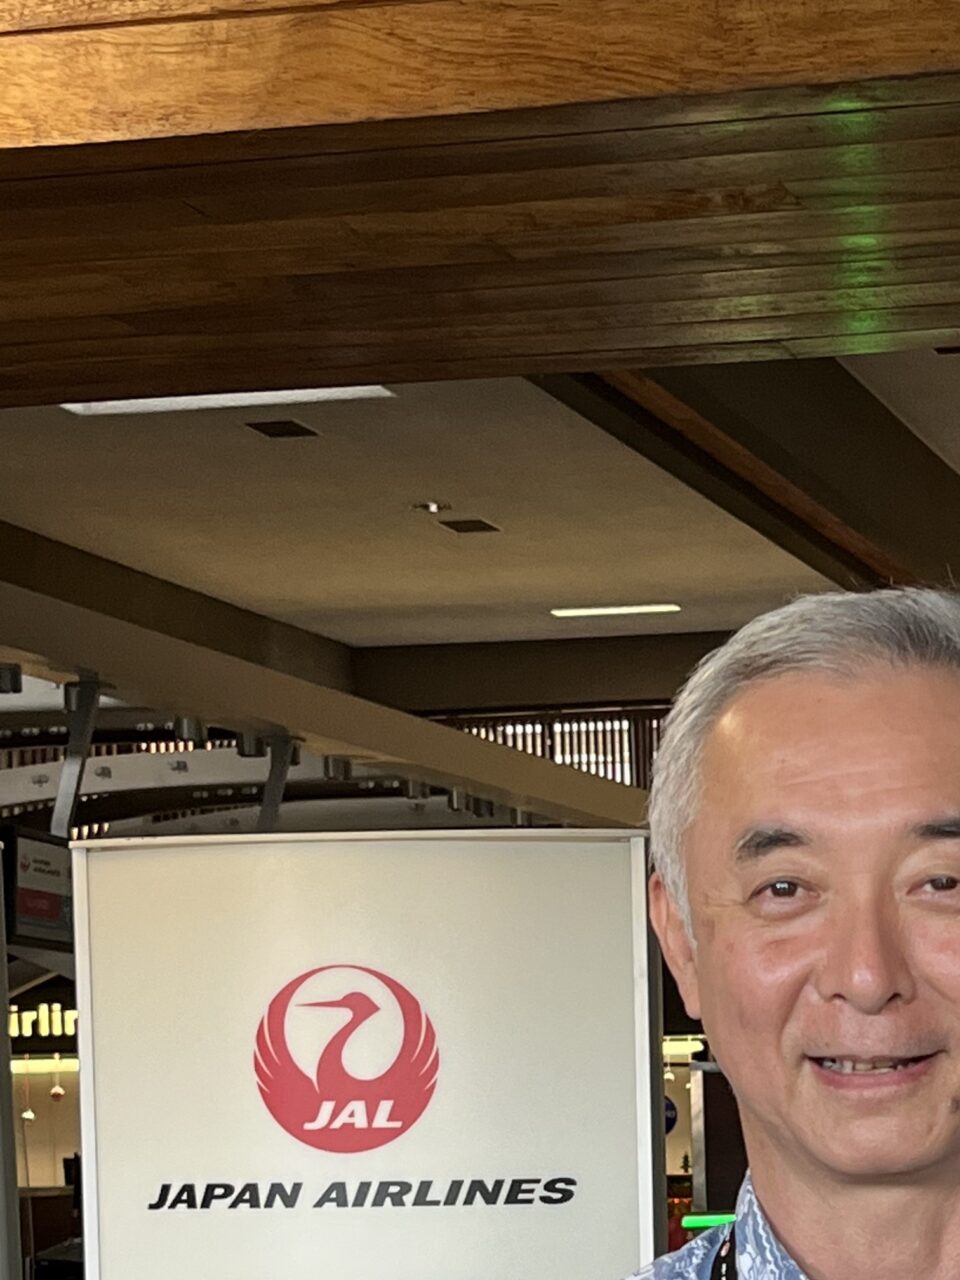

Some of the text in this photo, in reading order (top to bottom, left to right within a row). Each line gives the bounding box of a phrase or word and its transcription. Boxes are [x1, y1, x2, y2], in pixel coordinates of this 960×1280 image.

[303, 1100, 403, 1130] JAL
[147, 1177, 577, 1210] JAPAN AIRLINES
